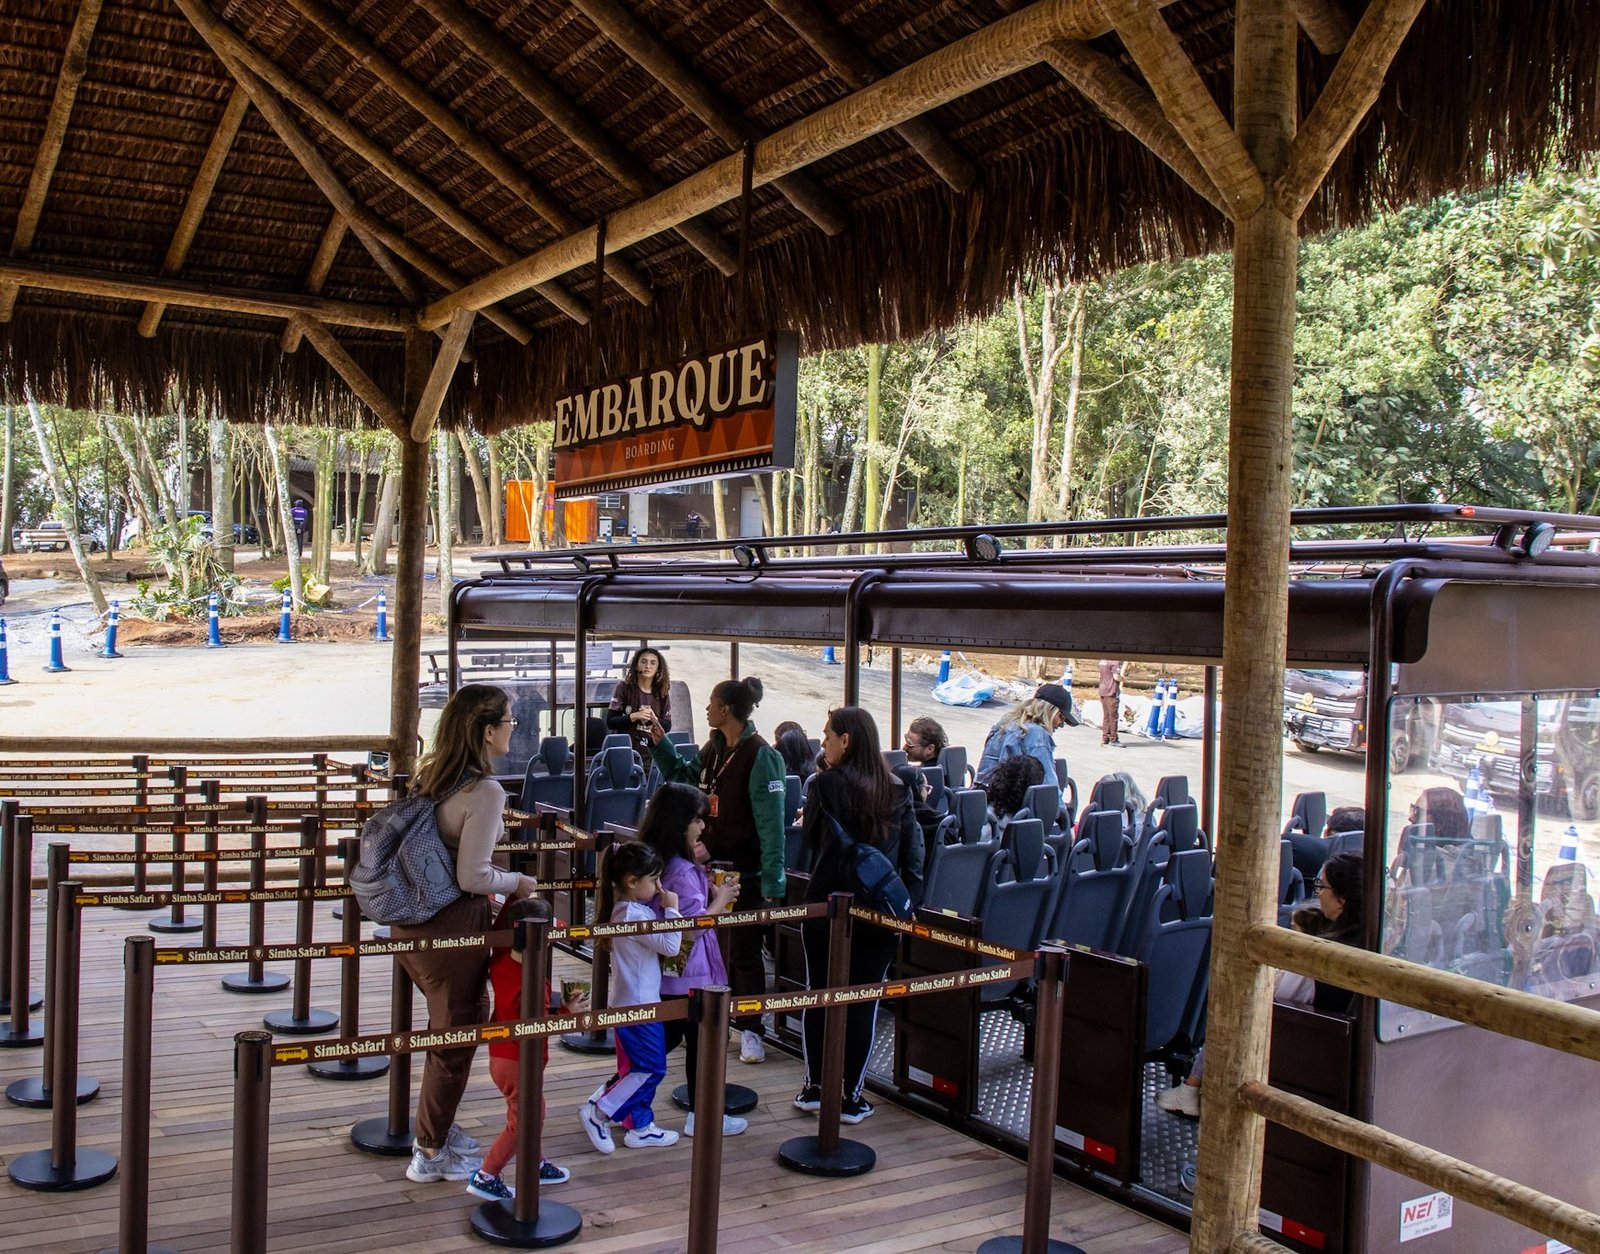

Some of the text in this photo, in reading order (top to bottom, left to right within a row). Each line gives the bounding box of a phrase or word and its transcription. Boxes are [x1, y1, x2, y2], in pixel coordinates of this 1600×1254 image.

[554, 340, 766, 448] EMBARQUE
[625, 437, 675, 460] BOARDING
[92, 848, 315, 862] Simba Safari Simba Safari Simba Safari Simba Safari
[103, 887, 353, 904] Simba Safari Simba Safari Simba Safari Simba Safa
[552, 880, 572, 890] Safari
[548, 906, 808, 939] afari Simba Safari Simba Safari Simba Safari Simba Safari
[856, 910, 872, 920] Safari
[880, 916, 896, 929] Simba
[897, 920, 912, 932] Safari
[931, 930, 949, 943] Simba
[950, 934, 966, 948] Safari
[978, 942, 996, 955] Simba
[996, 947, 1015, 960] Safari
[188, 935, 485, 962] Simba Safari Simba Safari Simba Safari Simba Safari
[766, 968, 1011, 1010] Simba Safari Simba Safari Simba Safari Simba Safari
[314, 1007, 656, 1058] Simba Safari Simba Safari Simba Safari Simba Safari
